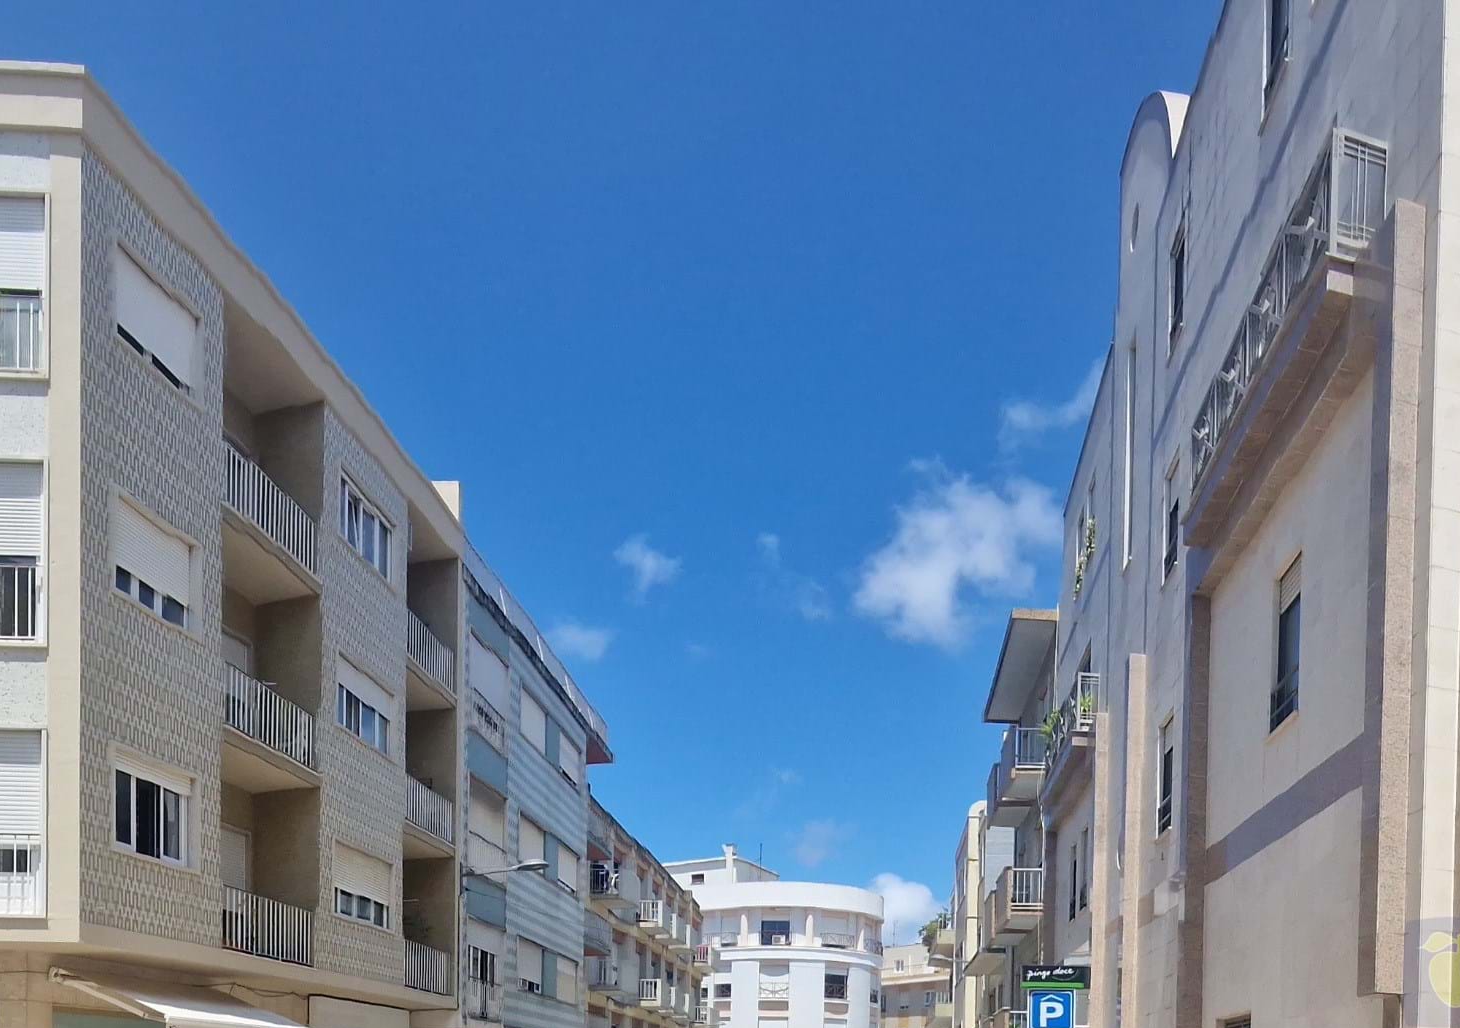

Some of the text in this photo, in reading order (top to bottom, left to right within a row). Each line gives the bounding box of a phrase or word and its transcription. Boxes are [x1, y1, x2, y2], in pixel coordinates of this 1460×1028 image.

[1026, 966, 1075, 981] pingo doce
[1040, 1001, 1065, 1028] P
